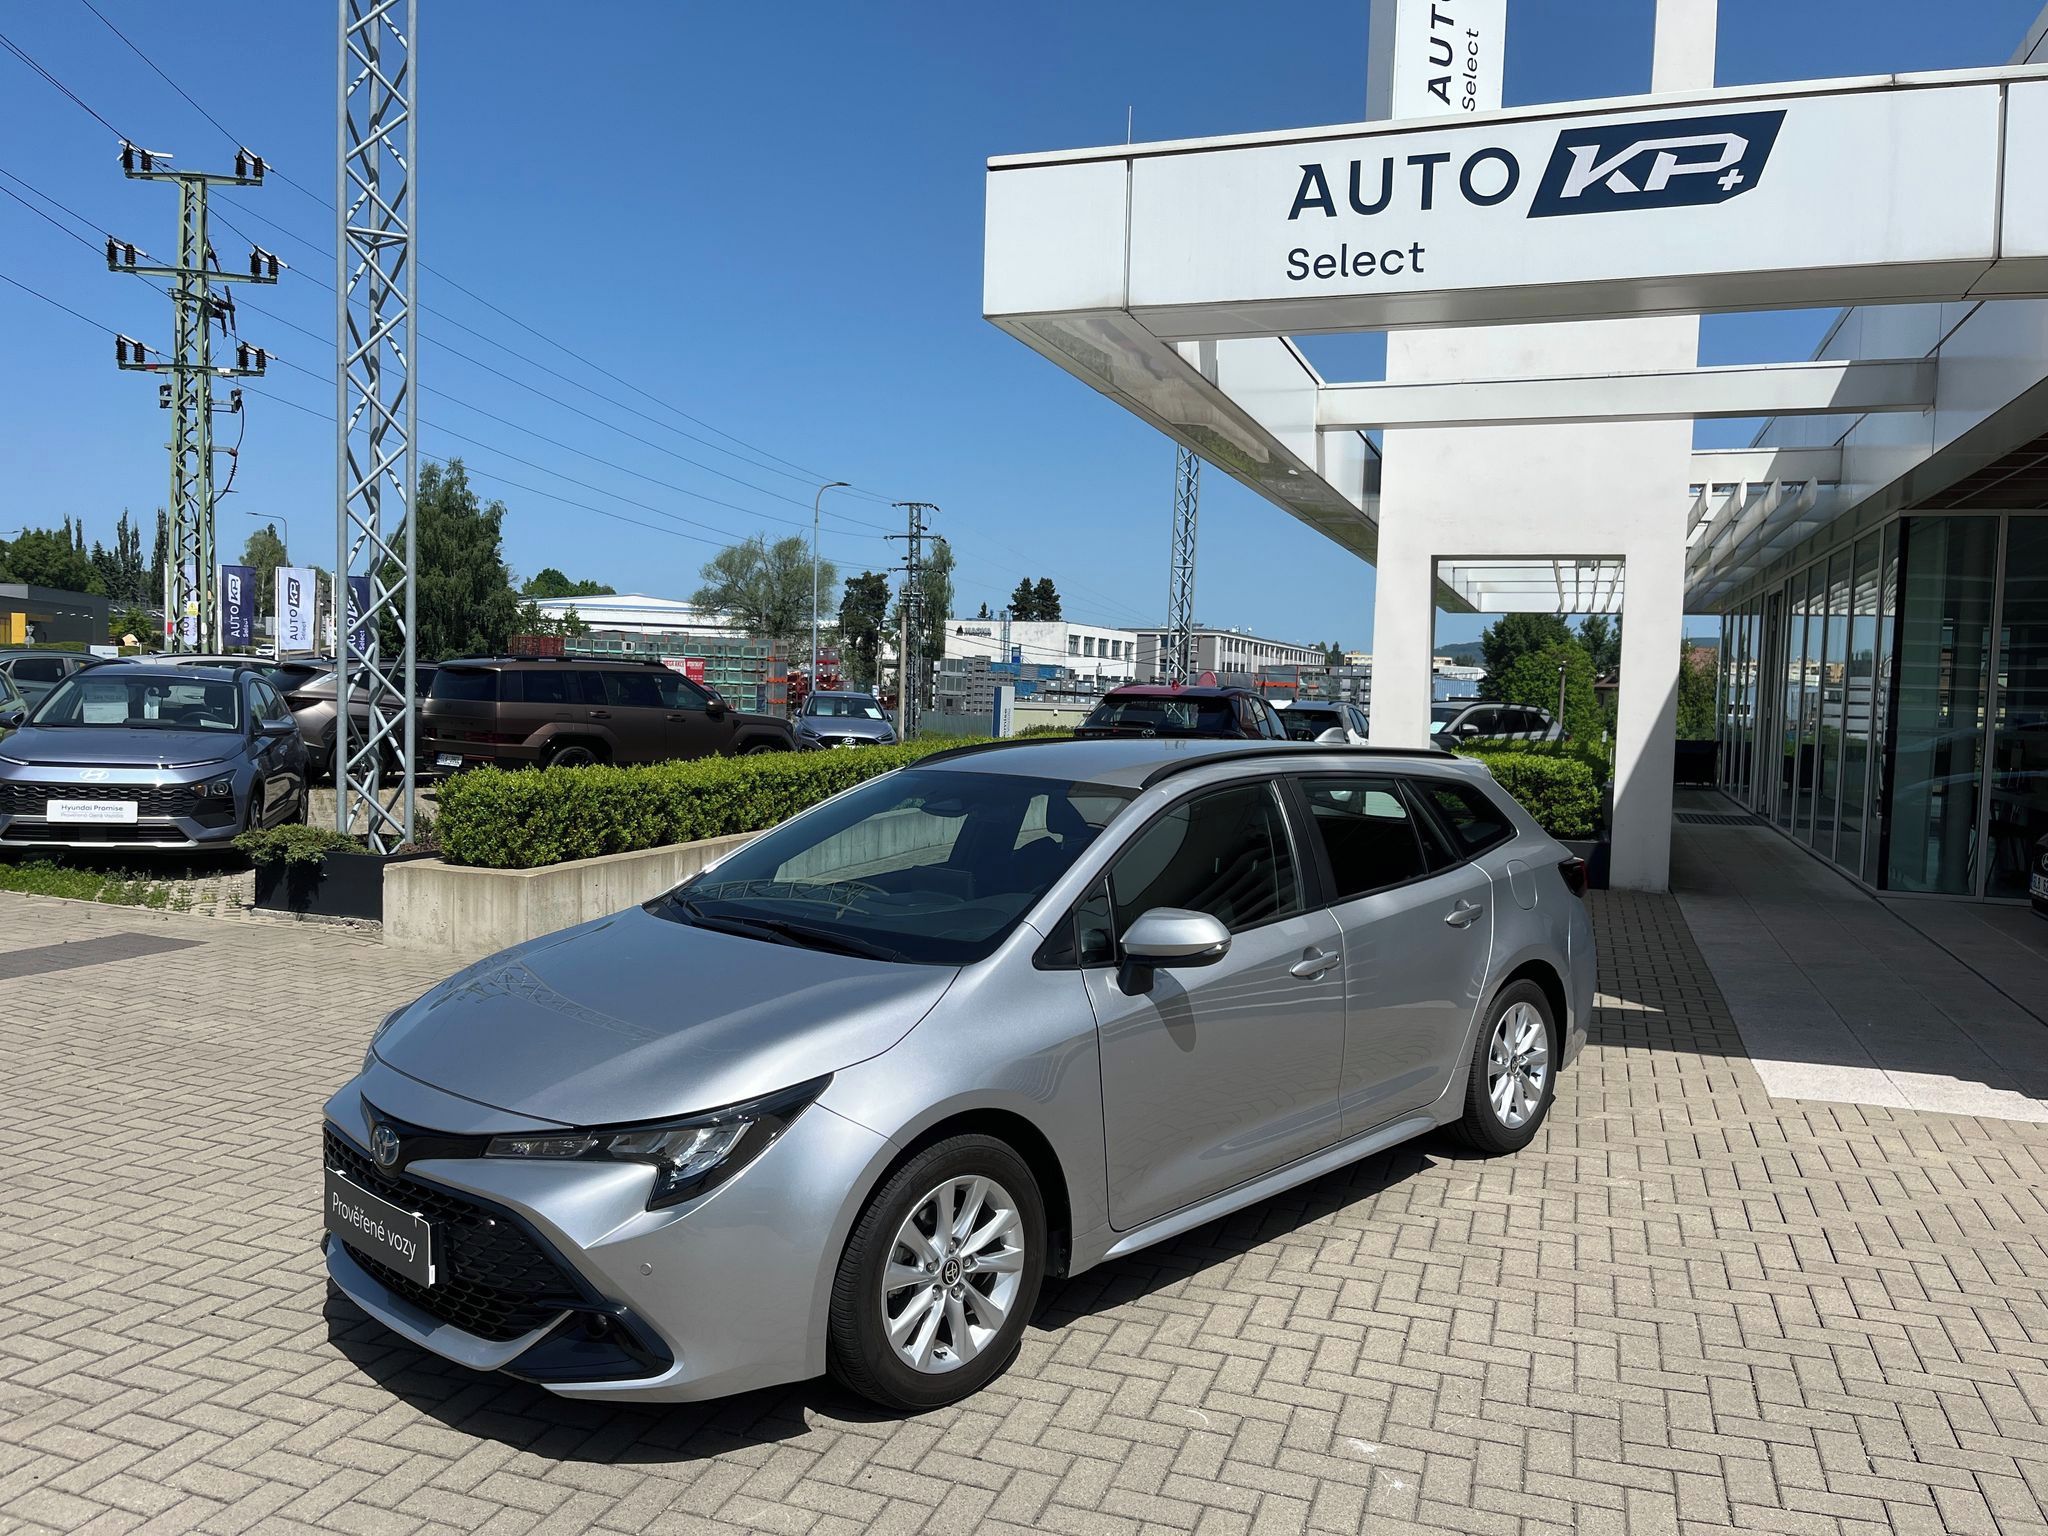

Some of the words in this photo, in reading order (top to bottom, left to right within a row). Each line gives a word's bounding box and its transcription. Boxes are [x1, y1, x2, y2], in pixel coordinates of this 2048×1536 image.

[1427, 0, 1455, 106] AUT
[1462, 28, 1479, 112] Select
[1287, 147, 1520, 220] AUTO
[1286, 242, 1425, 281] Select
[230, 605, 240, 638] AUTO
[289, 608, 299, 641] AUTO
[61, 804, 92, 812] Hyundai
[93, 804, 124, 812] Promise
[333, 1192, 385, 1242] Prověřené
[387, 1230, 416, 1262] vozy
